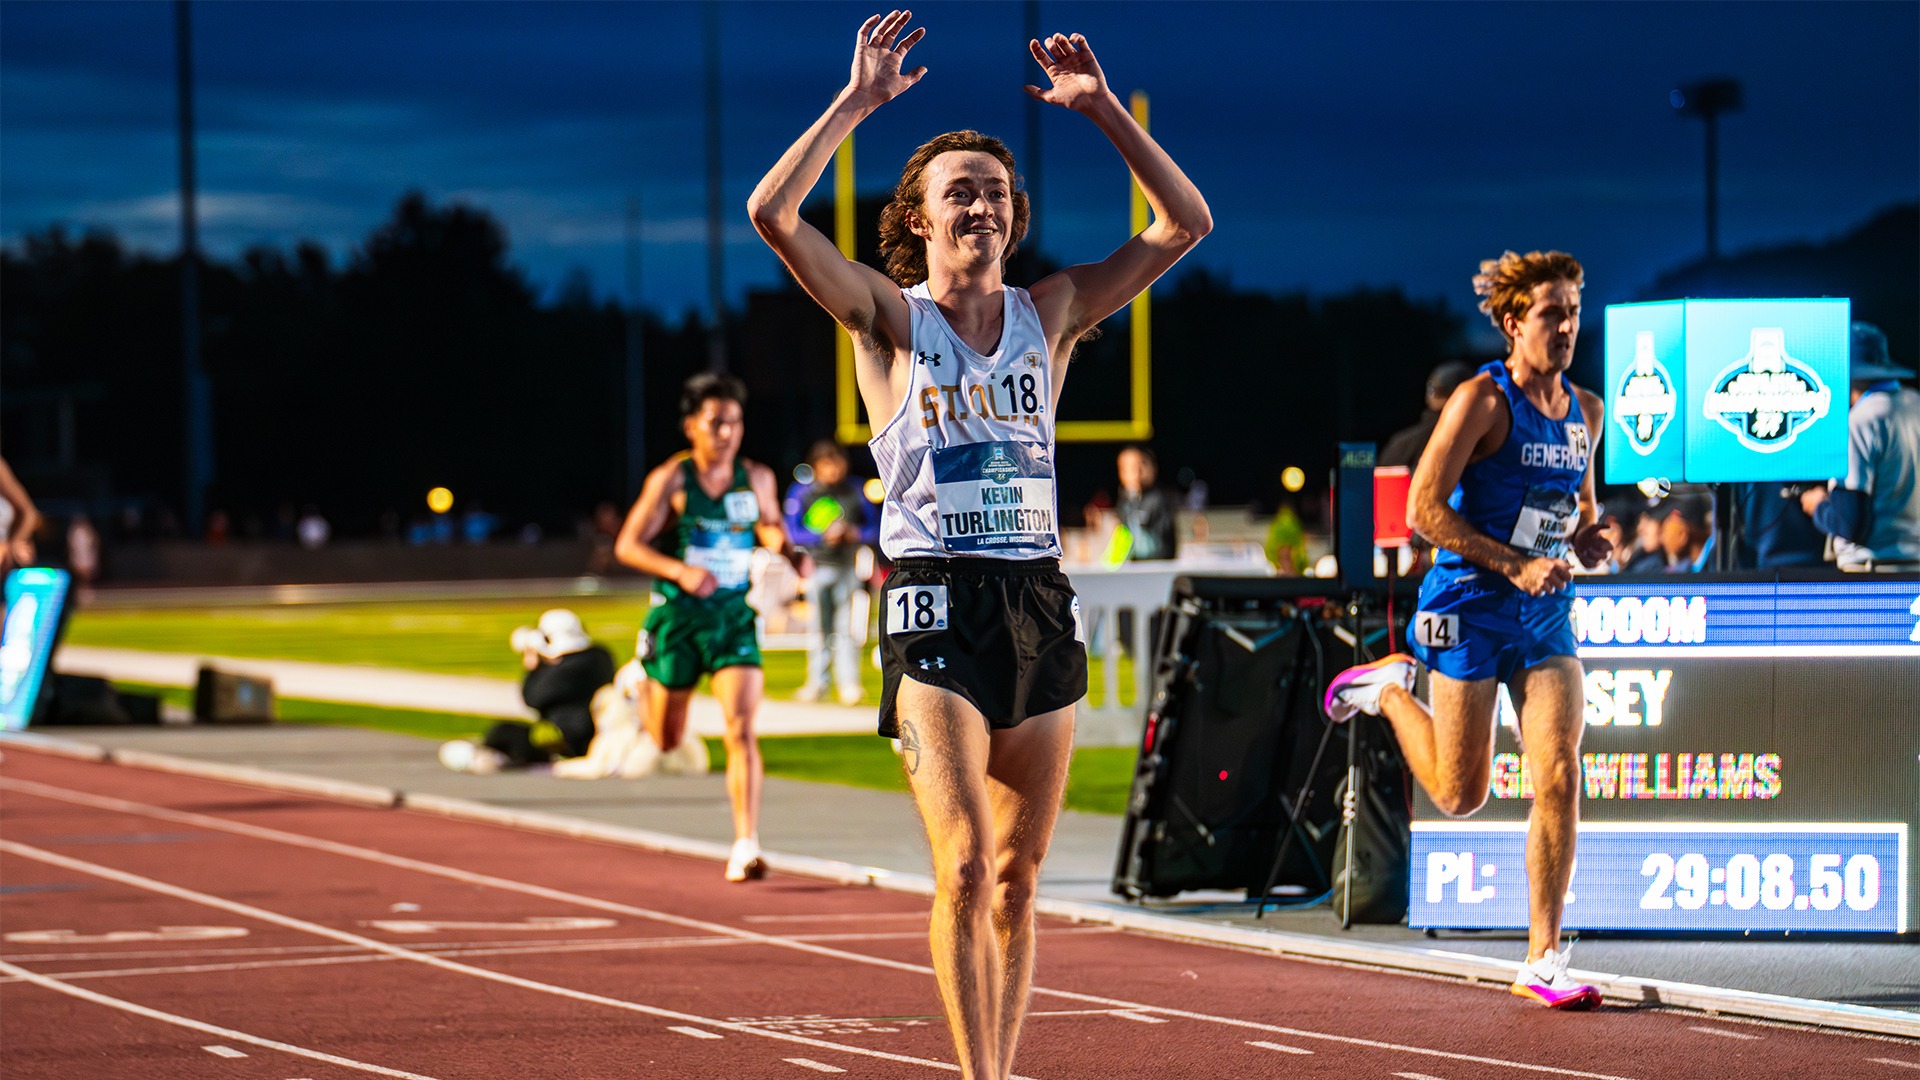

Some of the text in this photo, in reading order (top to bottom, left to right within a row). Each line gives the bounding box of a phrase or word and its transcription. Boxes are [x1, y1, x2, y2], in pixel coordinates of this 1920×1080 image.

[1001, 373, 1038, 414] 18
[981, 486, 1023, 506] KEVIN
[942, 508, 1052, 537] TURLINGTON
[985, 536, 1008, 545] CROSSE,
[896, 590, 935, 630] 18
[1423, 617, 1451, 645] 14
[1582, 752, 1783, 799] WILLIAMS
[1426, 851, 1497, 904] PL:
[1639, 853, 1881, 911] 29:08.50
